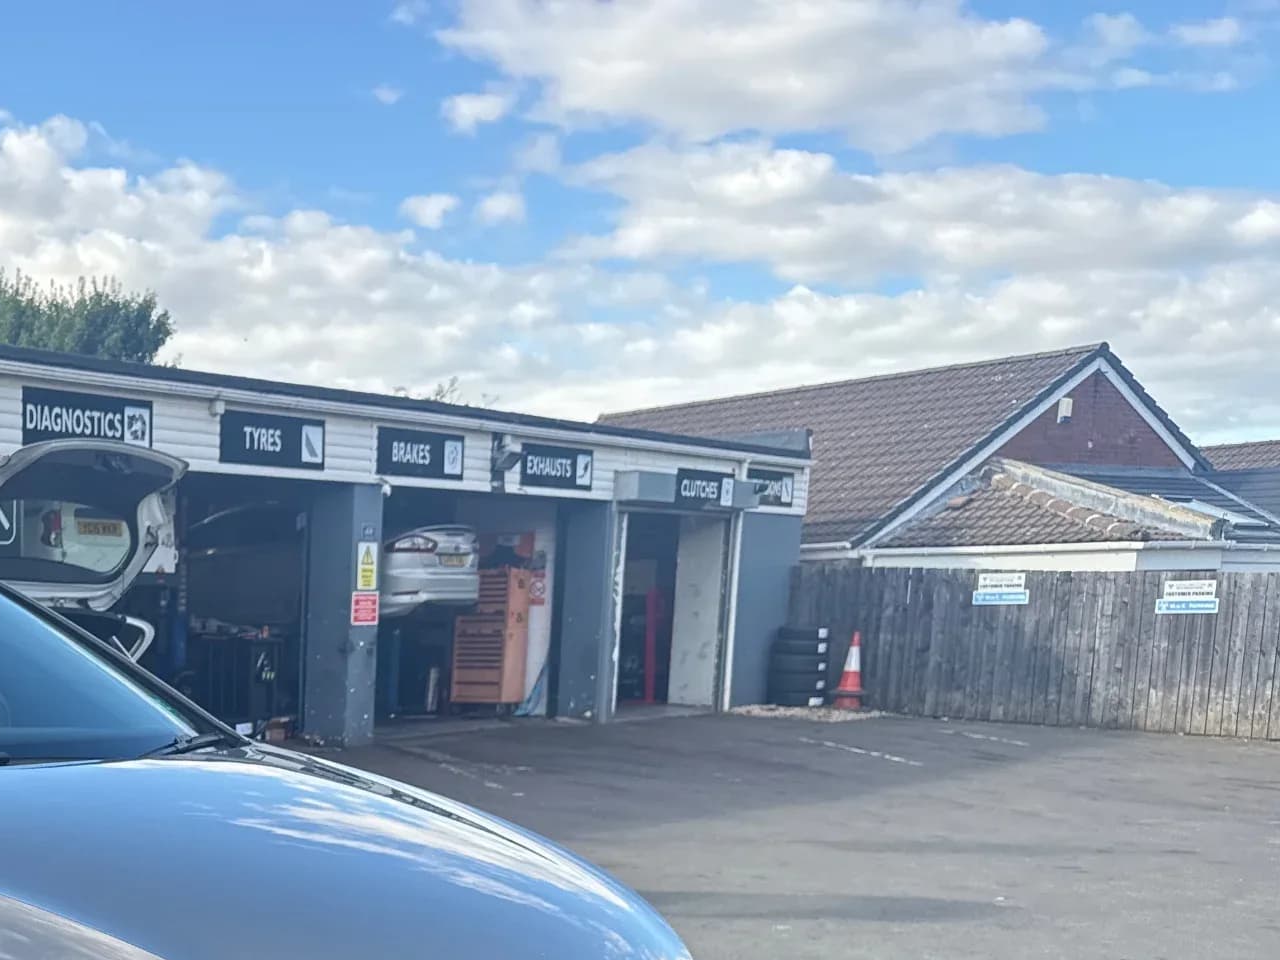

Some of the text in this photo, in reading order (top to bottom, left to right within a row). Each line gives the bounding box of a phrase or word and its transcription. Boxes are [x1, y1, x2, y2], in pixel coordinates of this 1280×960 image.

[25, 403, 122, 438] DIAGNOSTICS
[243, 426, 282, 452] TYRES
[392, 441, 431, 465] BRAKES
[526, 454, 573, 478] EXHAUSTS
[680, 479, 719, 499] CLUTCHES
